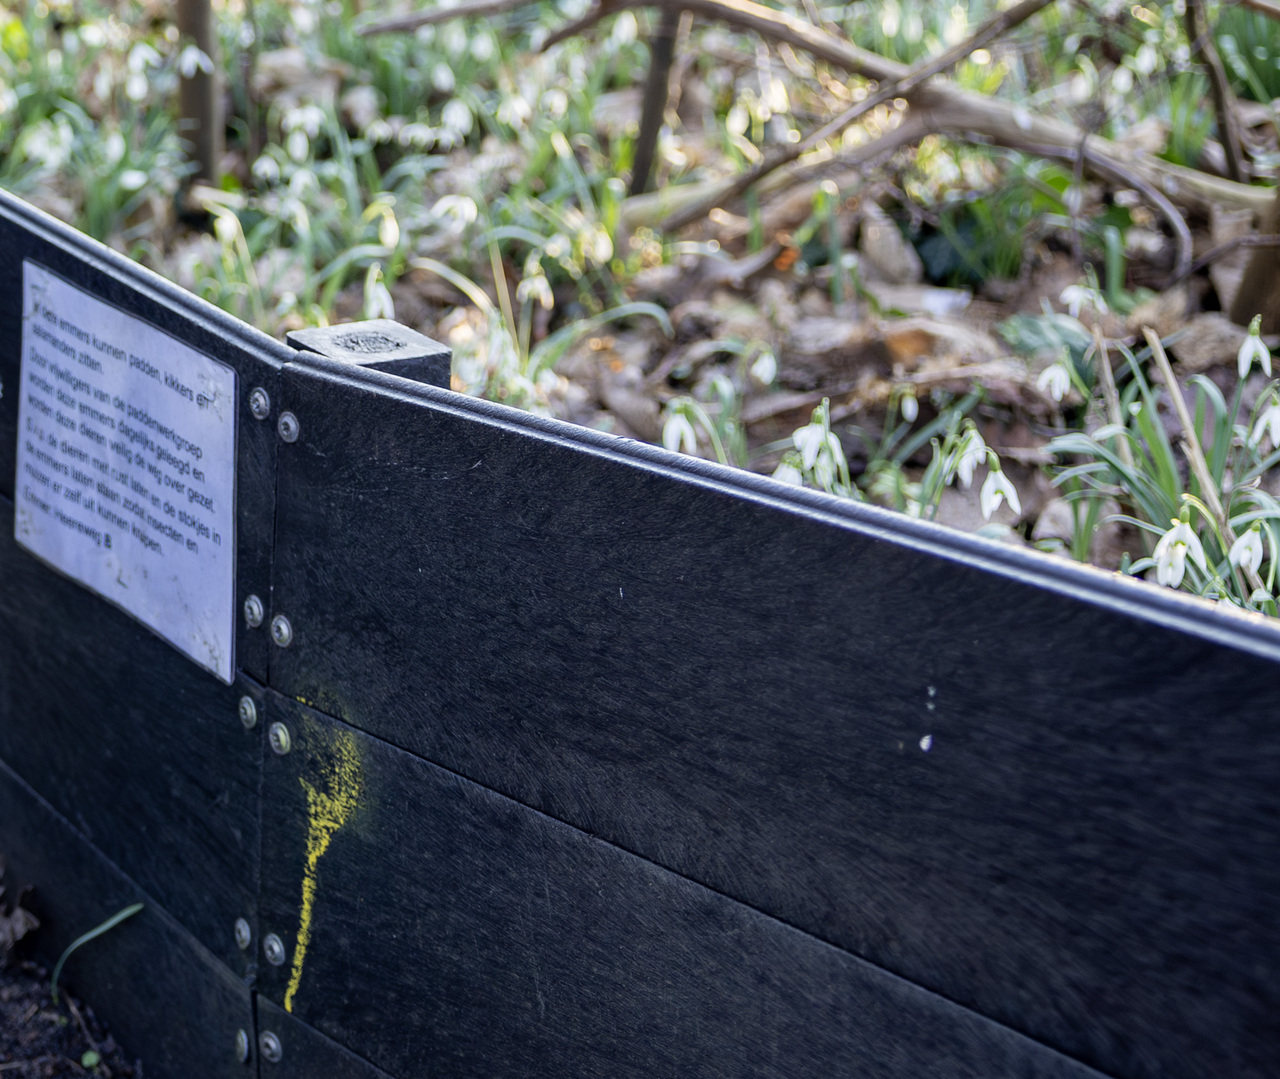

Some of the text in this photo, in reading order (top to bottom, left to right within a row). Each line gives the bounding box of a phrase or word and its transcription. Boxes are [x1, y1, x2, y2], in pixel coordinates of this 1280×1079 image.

[60, 318, 90, 345] emmers
[92, 333, 126, 361] kunnen
[129, 354, 162, 385] padden,
[164, 371, 193, 401] kikkers
[196, 394, 209, 409] en
[55, 410, 76, 431] deze
[79, 422, 107, 446] dieren
[110, 440, 132, 465] veilig
[134, 452, 145, 469] de
[148, 462, 162, 485] weg
[164, 475, 185, 494] over
[57, 388, 76, 409] deze
[78, 402, 115, 429] emmers
[117, 420, 154, 453] dagelijks
[156, 445, 190, 475] geleegd
[192, 468, 205, 483] en
[93, 388, 110, 404] van
[112, 395, 124, 411] de
[127, 404, 203, 460] paddenwerkgroep
[36, 448, 69, 476] emmers
[71, 465, 95, 489] laten
[96, 481, 121, 503] staan
[122, 496, 146, 520] zodat
[147, 514, 184, 545] insecten
[186, 538, 198, 554] en
[48, 433, 58, 449] de
[61, 440, 90, 464] dieren
[92, 457, 109, 475] met
[111, 467, 128, 486] rust
[130, 474, 149, 499] laten
[151, 494, 161, 509] en
[163, 501, 175, 518] de
[178, 510, 210, 539] stokjes
[212, 527, 221, 546] in
[63, 486, 82, 504] zelf
[83, 497, 95, 512] uit
[97, 502, 130, 533] kunnen
